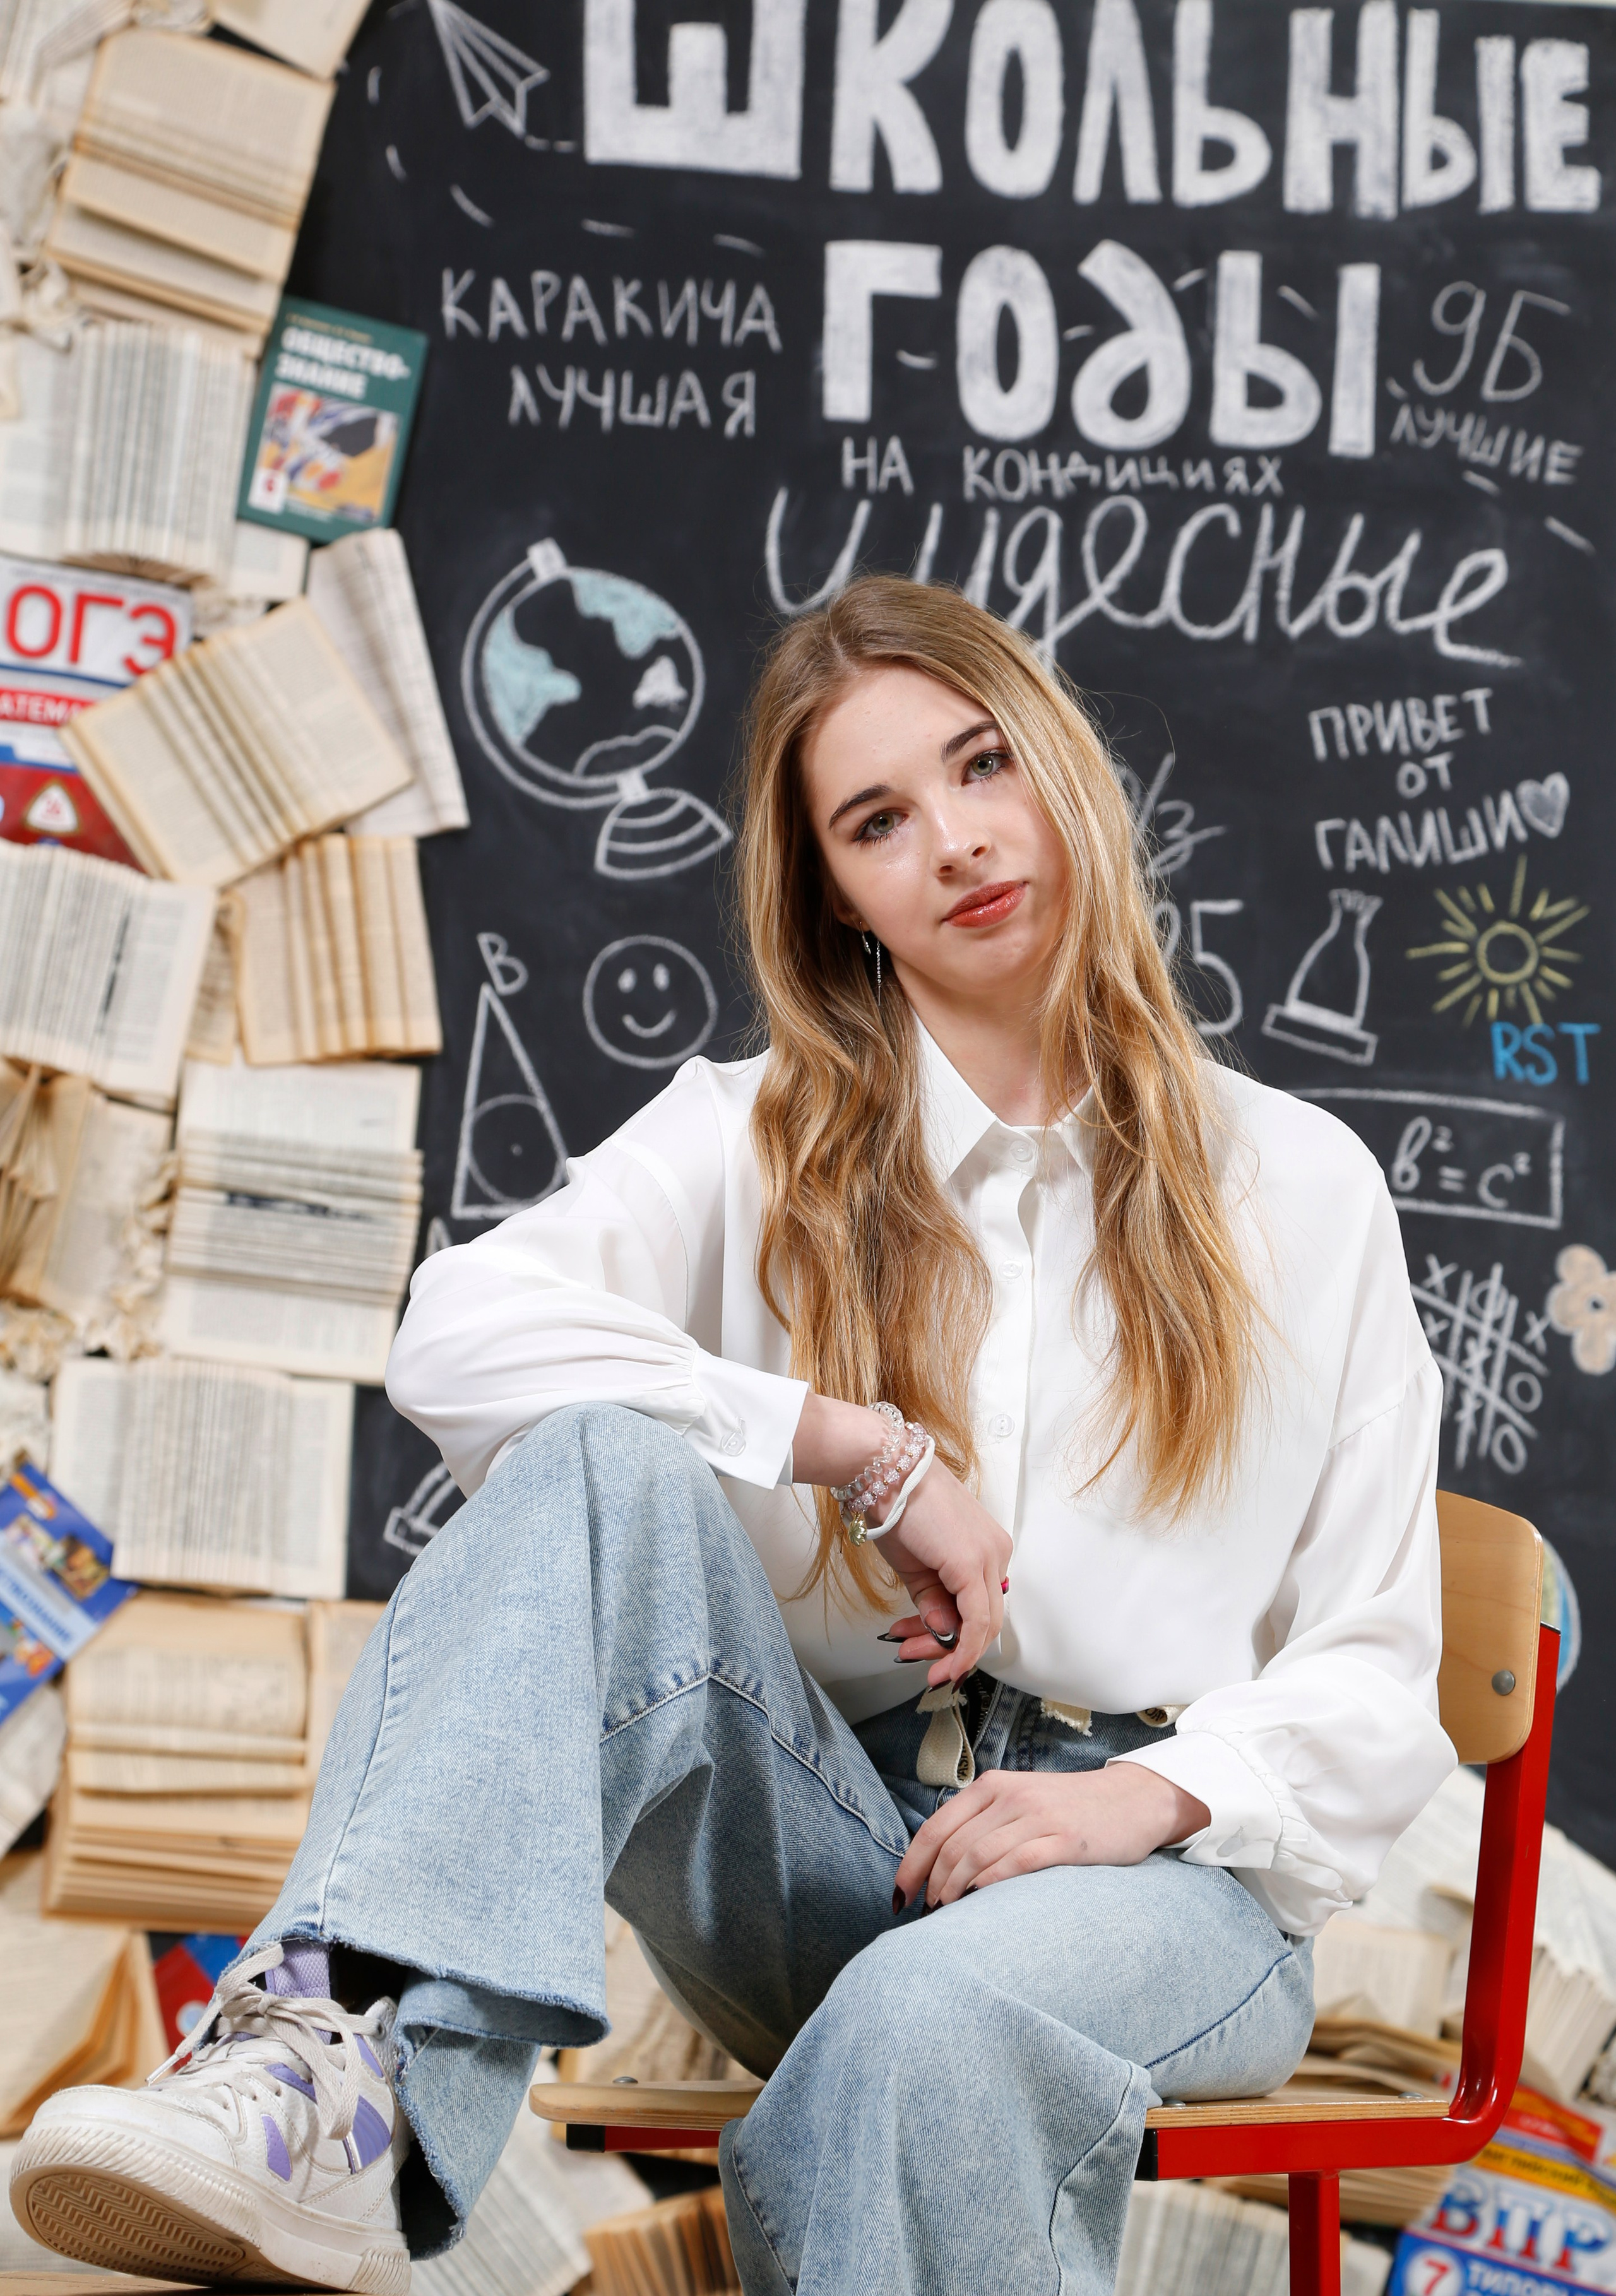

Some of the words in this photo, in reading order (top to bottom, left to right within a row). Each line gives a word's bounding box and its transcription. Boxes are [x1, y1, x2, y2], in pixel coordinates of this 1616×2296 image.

[583, 0, 1601, 220] ШКОЛЬНЫЕ
[441, 266, 783, 353] КАРАКИЧА
[821, 239, 1381, 459] ГОДЫ
[1413, 280, 1571, 403] 9Б
[275, 353, 368, 399] ЗНАНИЕ
[507, 364, 756, 440] ЛУЧШАЯ
[841, 435, 915, 496] НА
[963, 444, 1283, 502] КОНДИЦИЯХ
[1390, 403, 1583, 485] ЛУЧШИЕ
[4, 581, 178, 677] ОГЭ
[1308, 687, 1494, 762] ПРИВЕТ
[1395, 750, 1453, 799] ОТ
[1314, 790, 1529, 875] ГАЛИШИ
[1490, 1022, 1602, 1087] RST
[1430, 2177, 1612, 2272] ВПР
